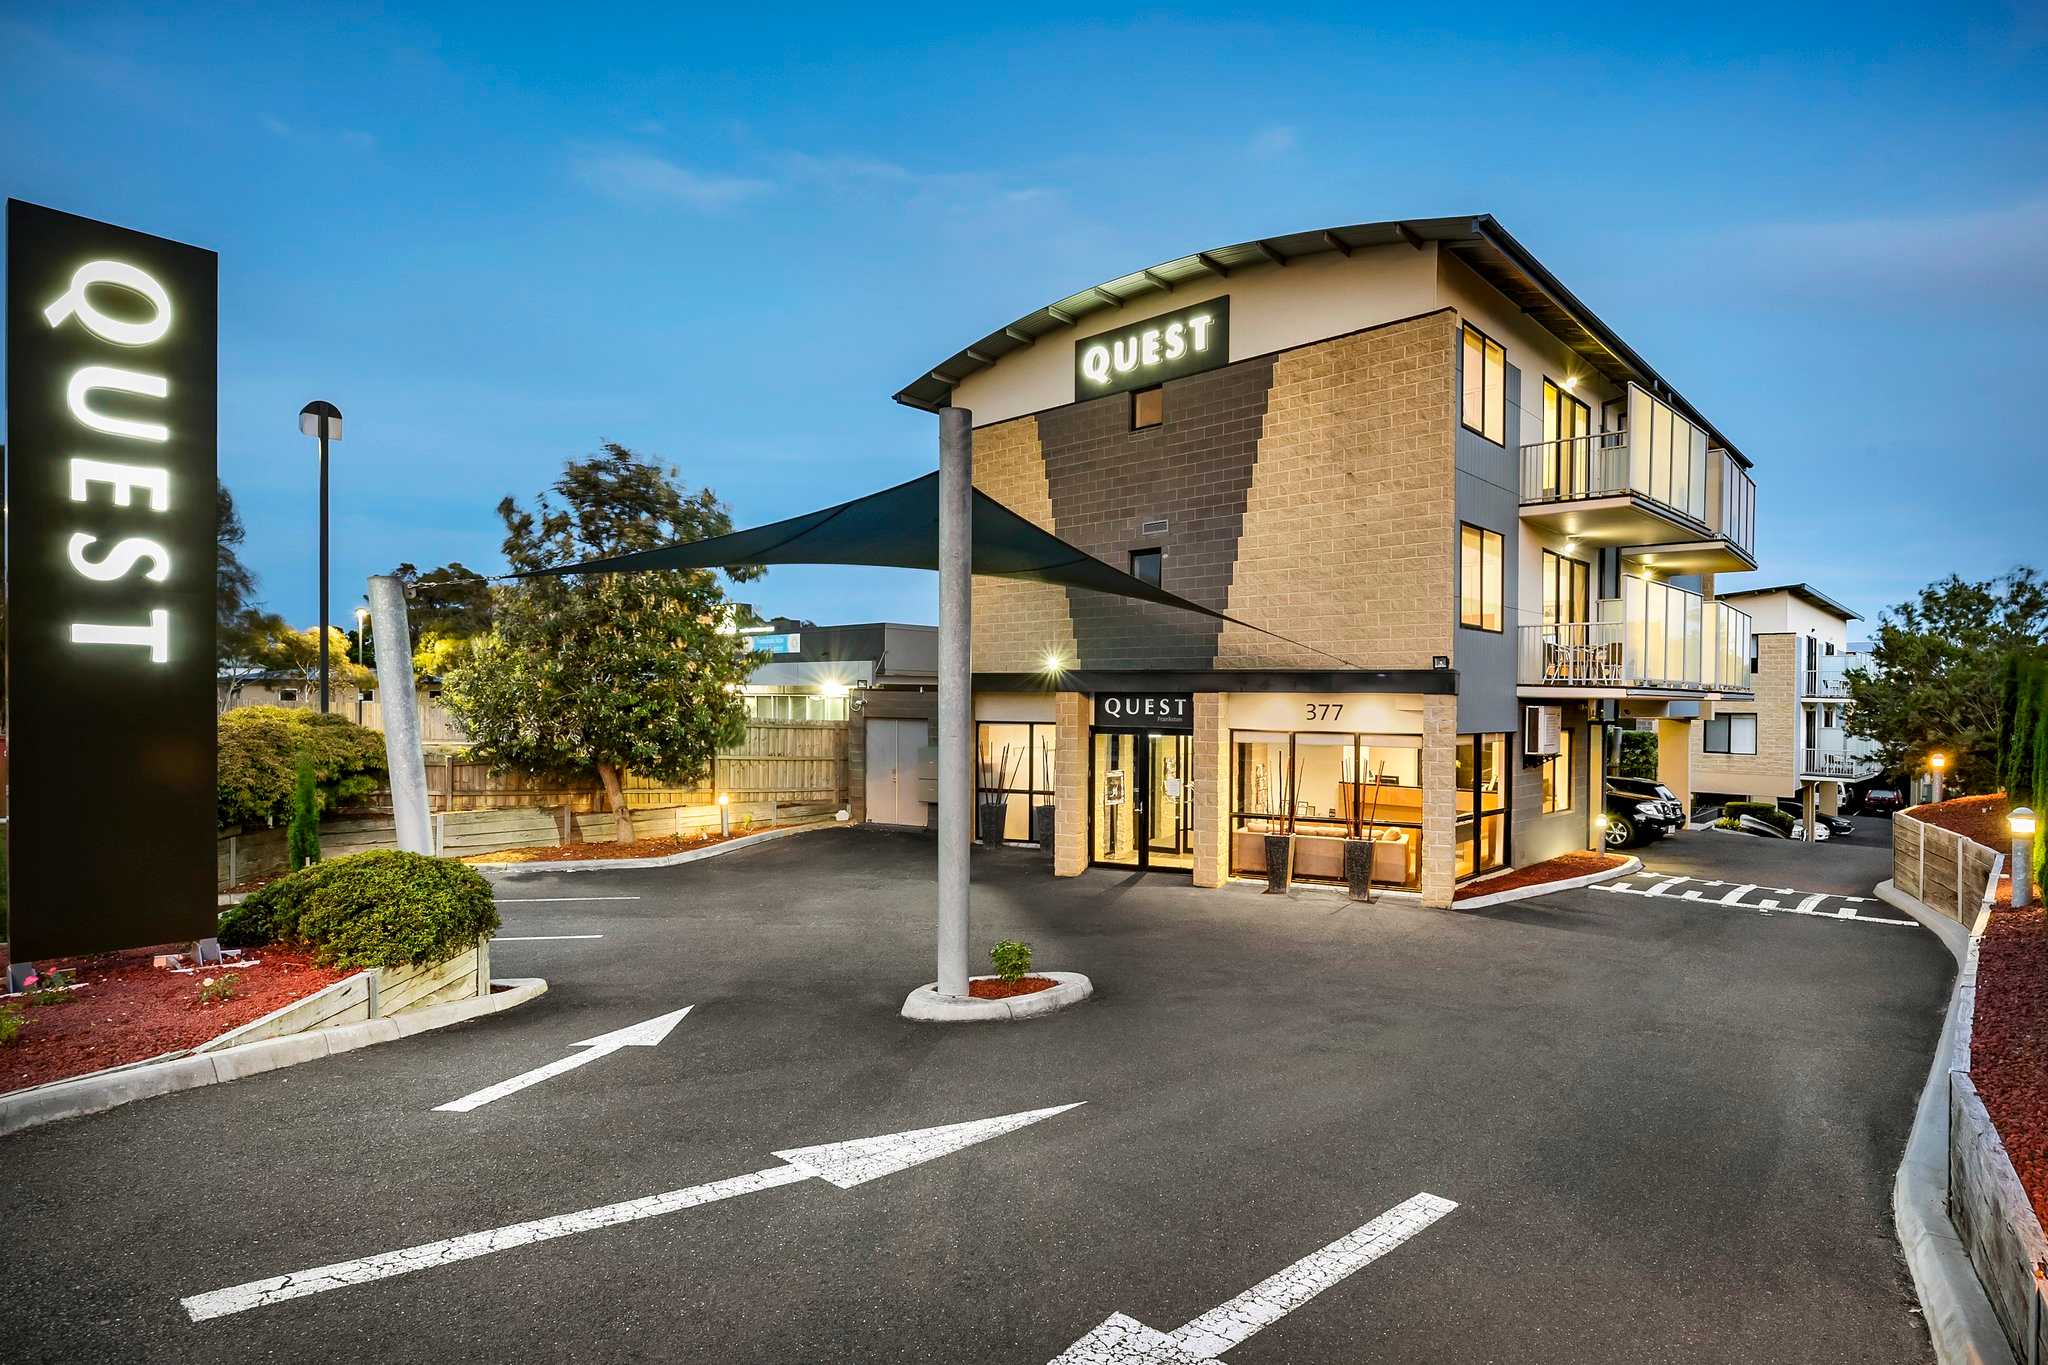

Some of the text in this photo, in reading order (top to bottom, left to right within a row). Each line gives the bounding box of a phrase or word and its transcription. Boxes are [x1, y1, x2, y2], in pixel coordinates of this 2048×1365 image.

[1082, 315, 1213, 384] QUEST
[44, 260, 171, 663] QUEST
[1104, 697, 1187, 718] QUEST
[1305, 703, 1344, 721] 377
